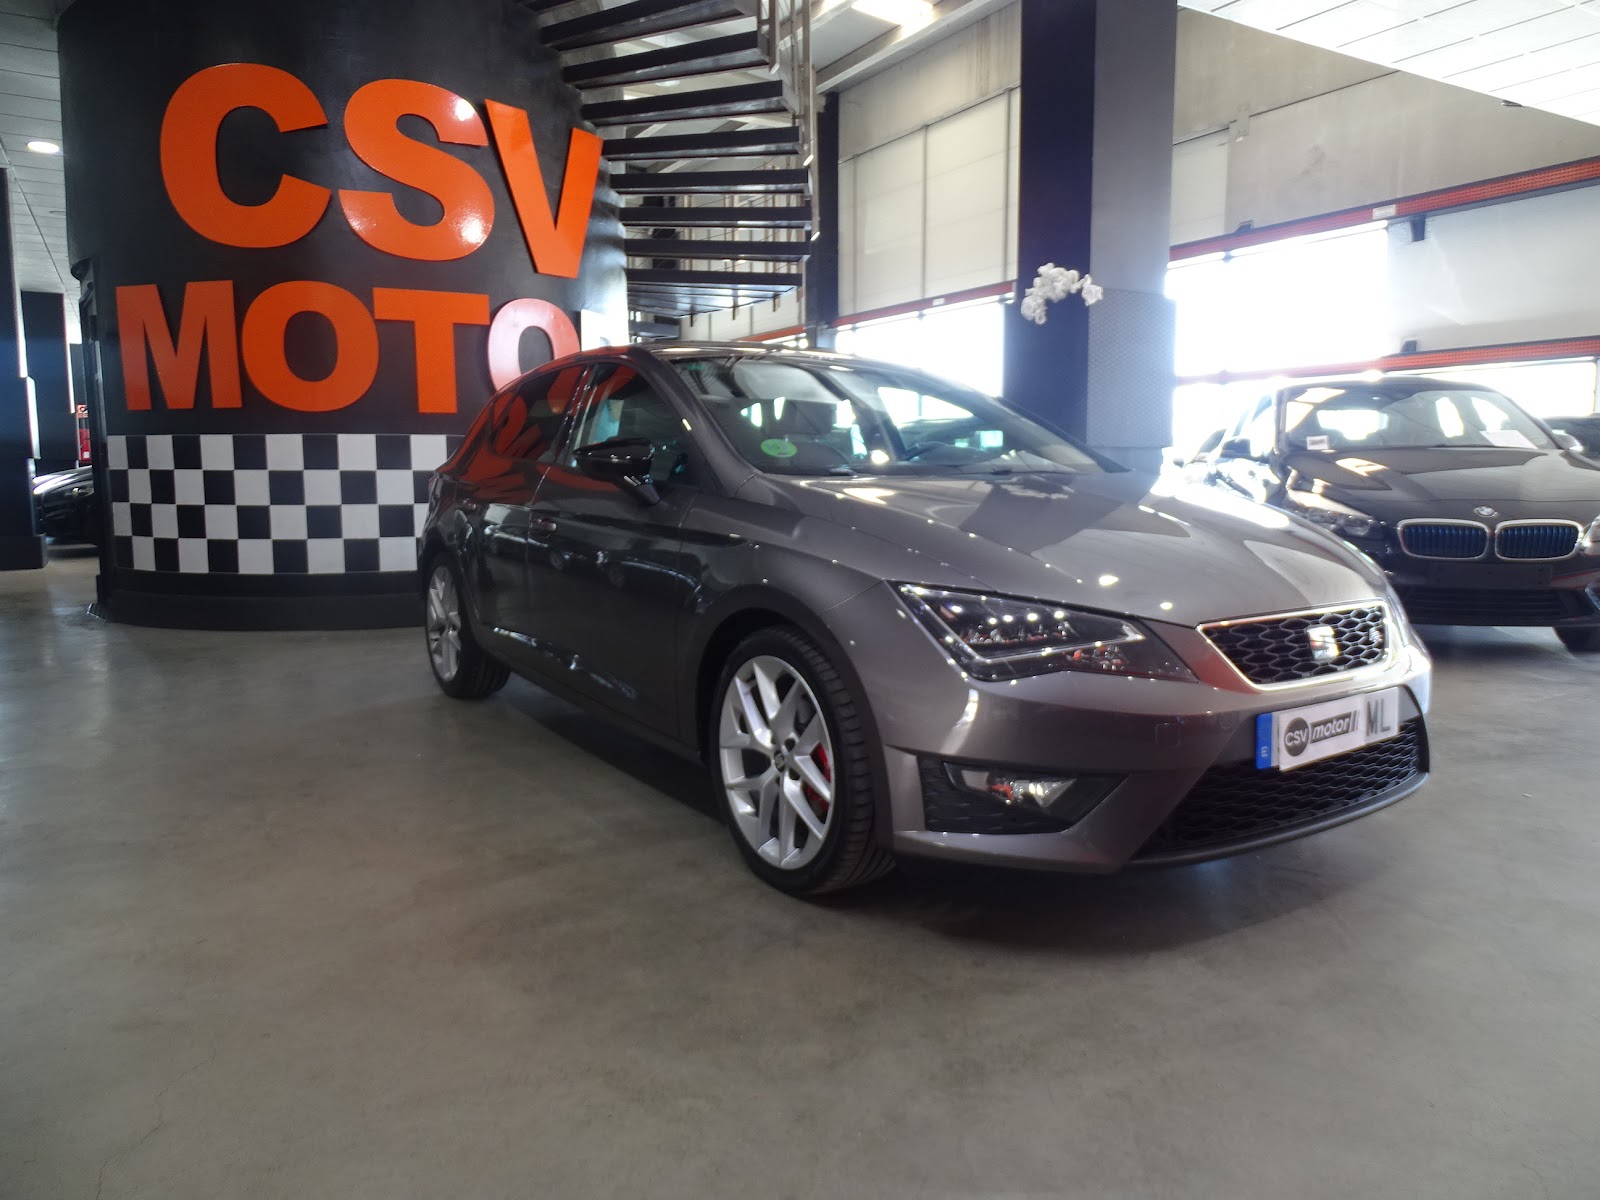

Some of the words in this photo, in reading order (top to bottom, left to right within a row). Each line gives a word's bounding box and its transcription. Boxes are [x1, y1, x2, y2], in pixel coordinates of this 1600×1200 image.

[160, 63, 604, 279] CSV
[1366, 698, 1391, 737] ML
[1285, 728, 1308, 747] CSV
